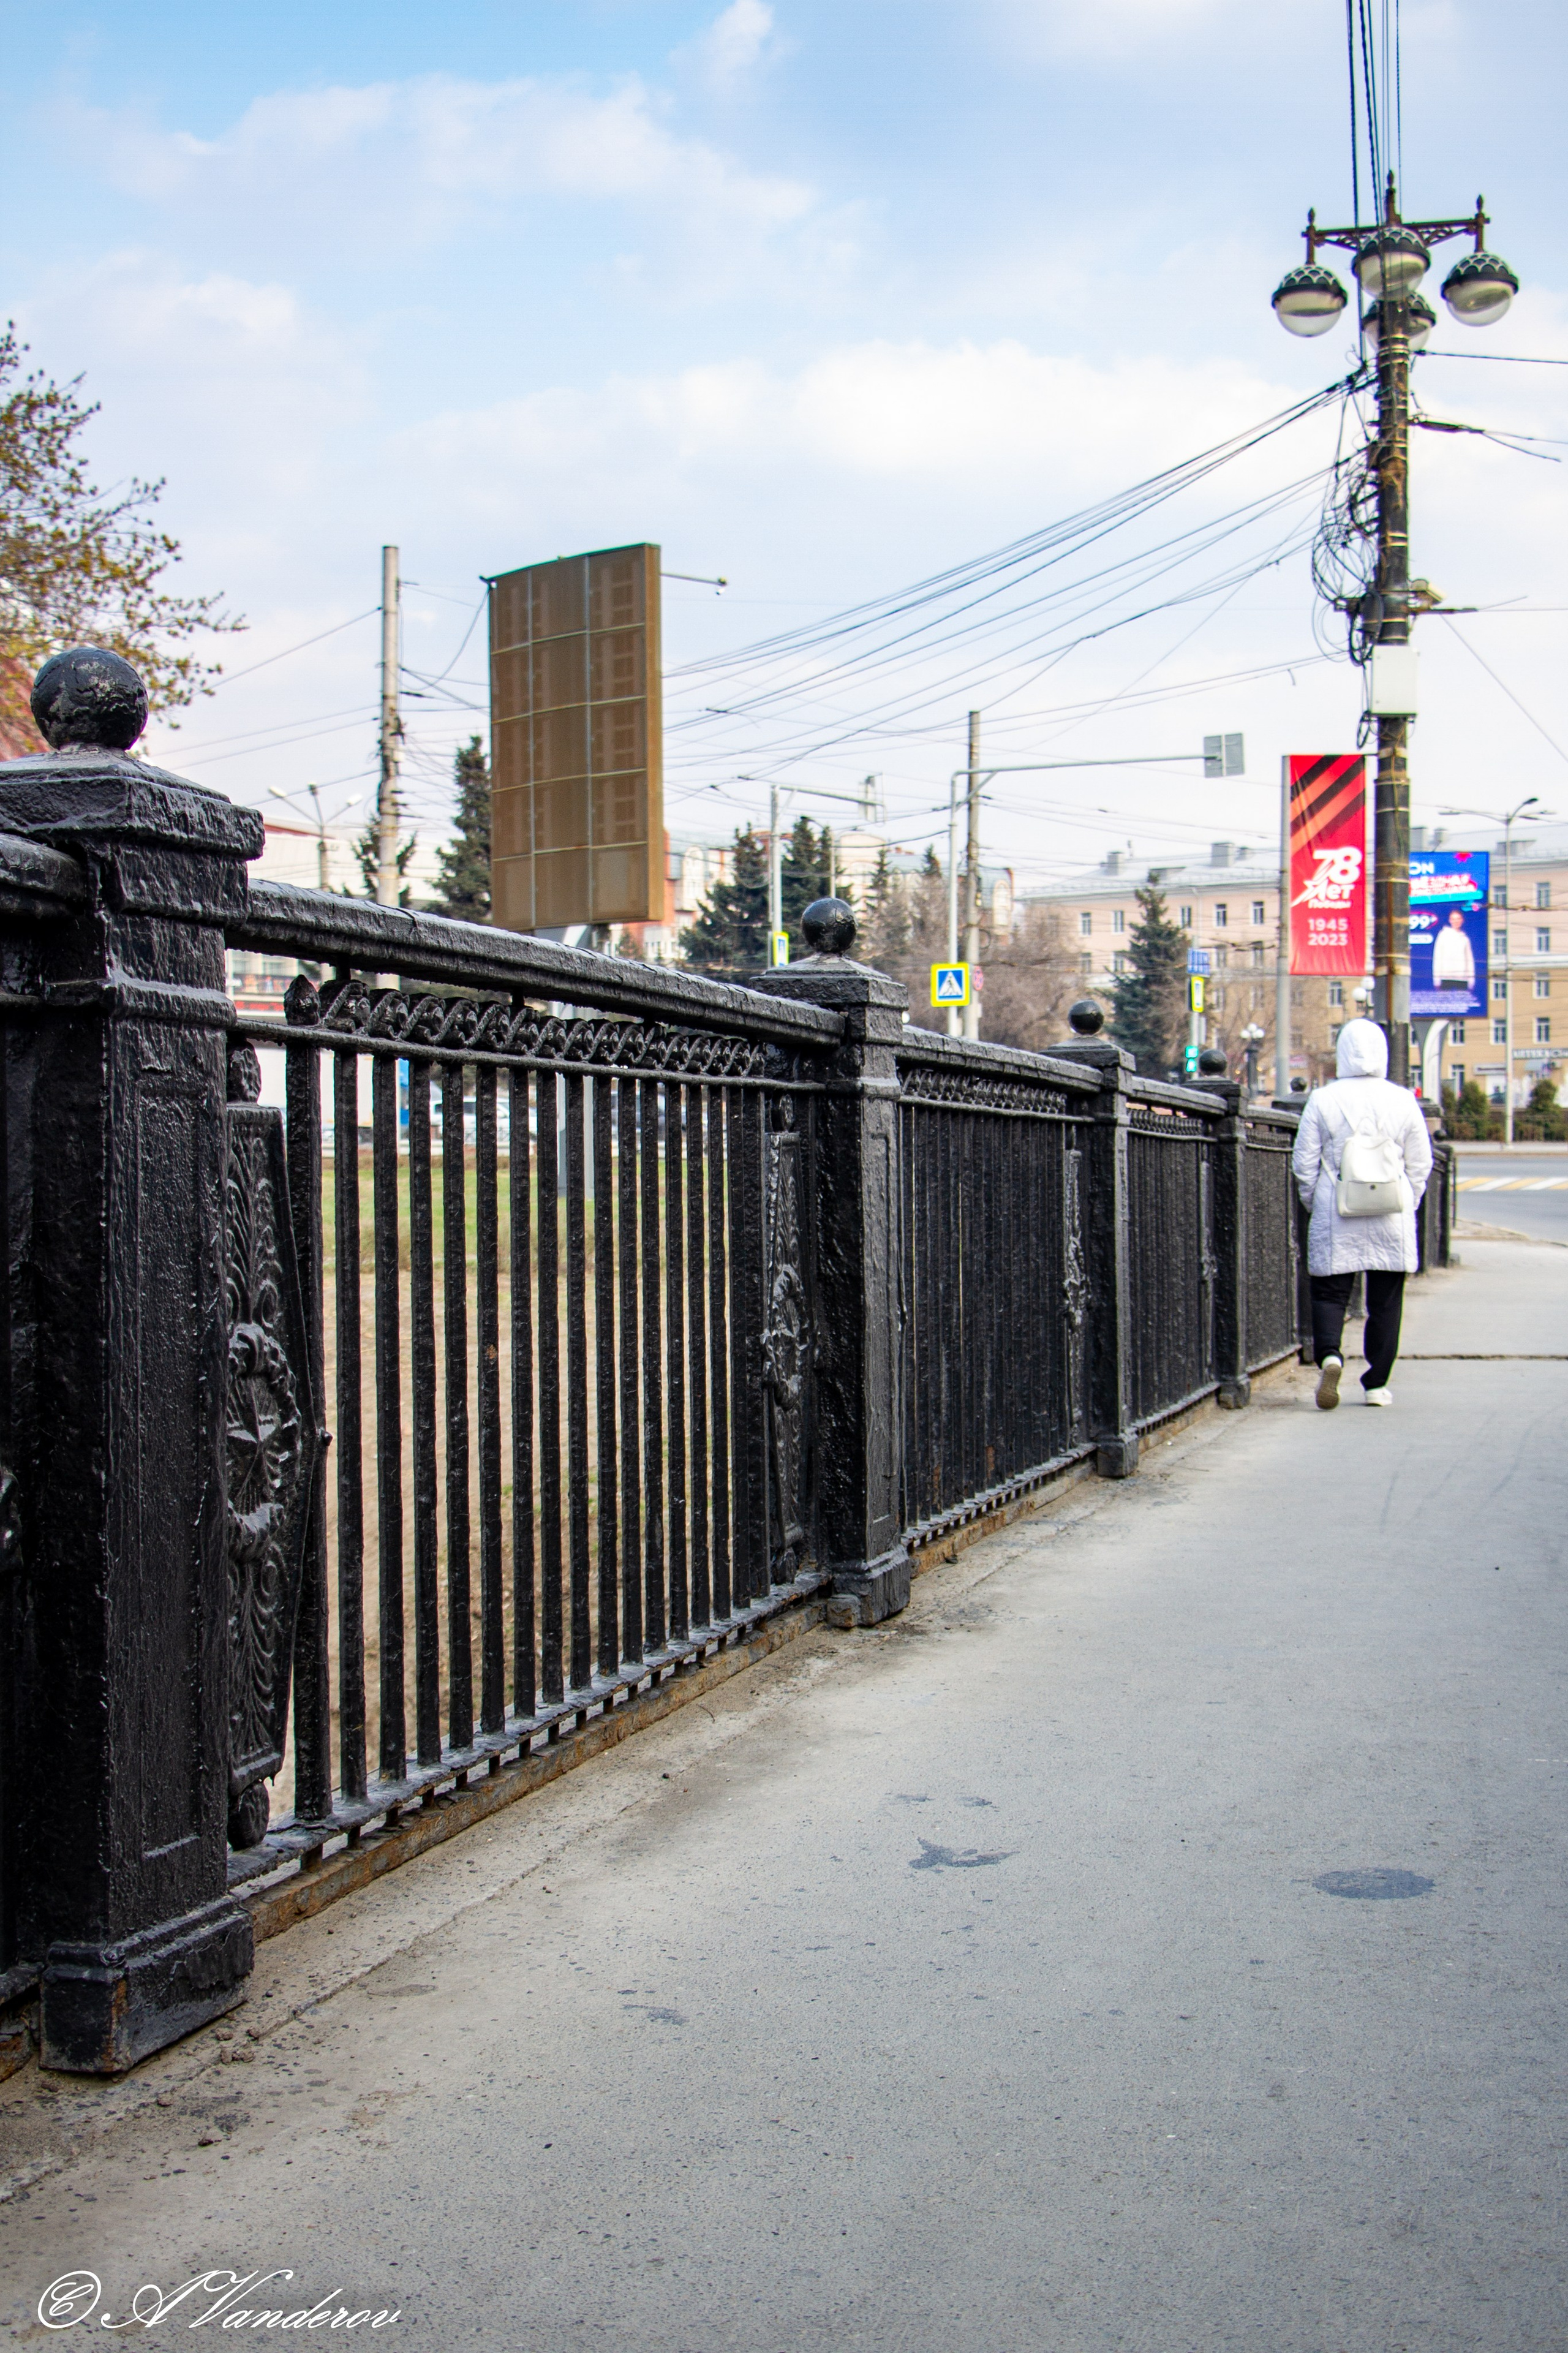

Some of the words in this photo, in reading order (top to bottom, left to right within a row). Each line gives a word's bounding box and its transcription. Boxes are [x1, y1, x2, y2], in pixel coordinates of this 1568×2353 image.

[1312, 846, 1363, 885] 78
[1308, 918, 1349, 931] 1945
[1307, 932, 1349, 946] 2023
